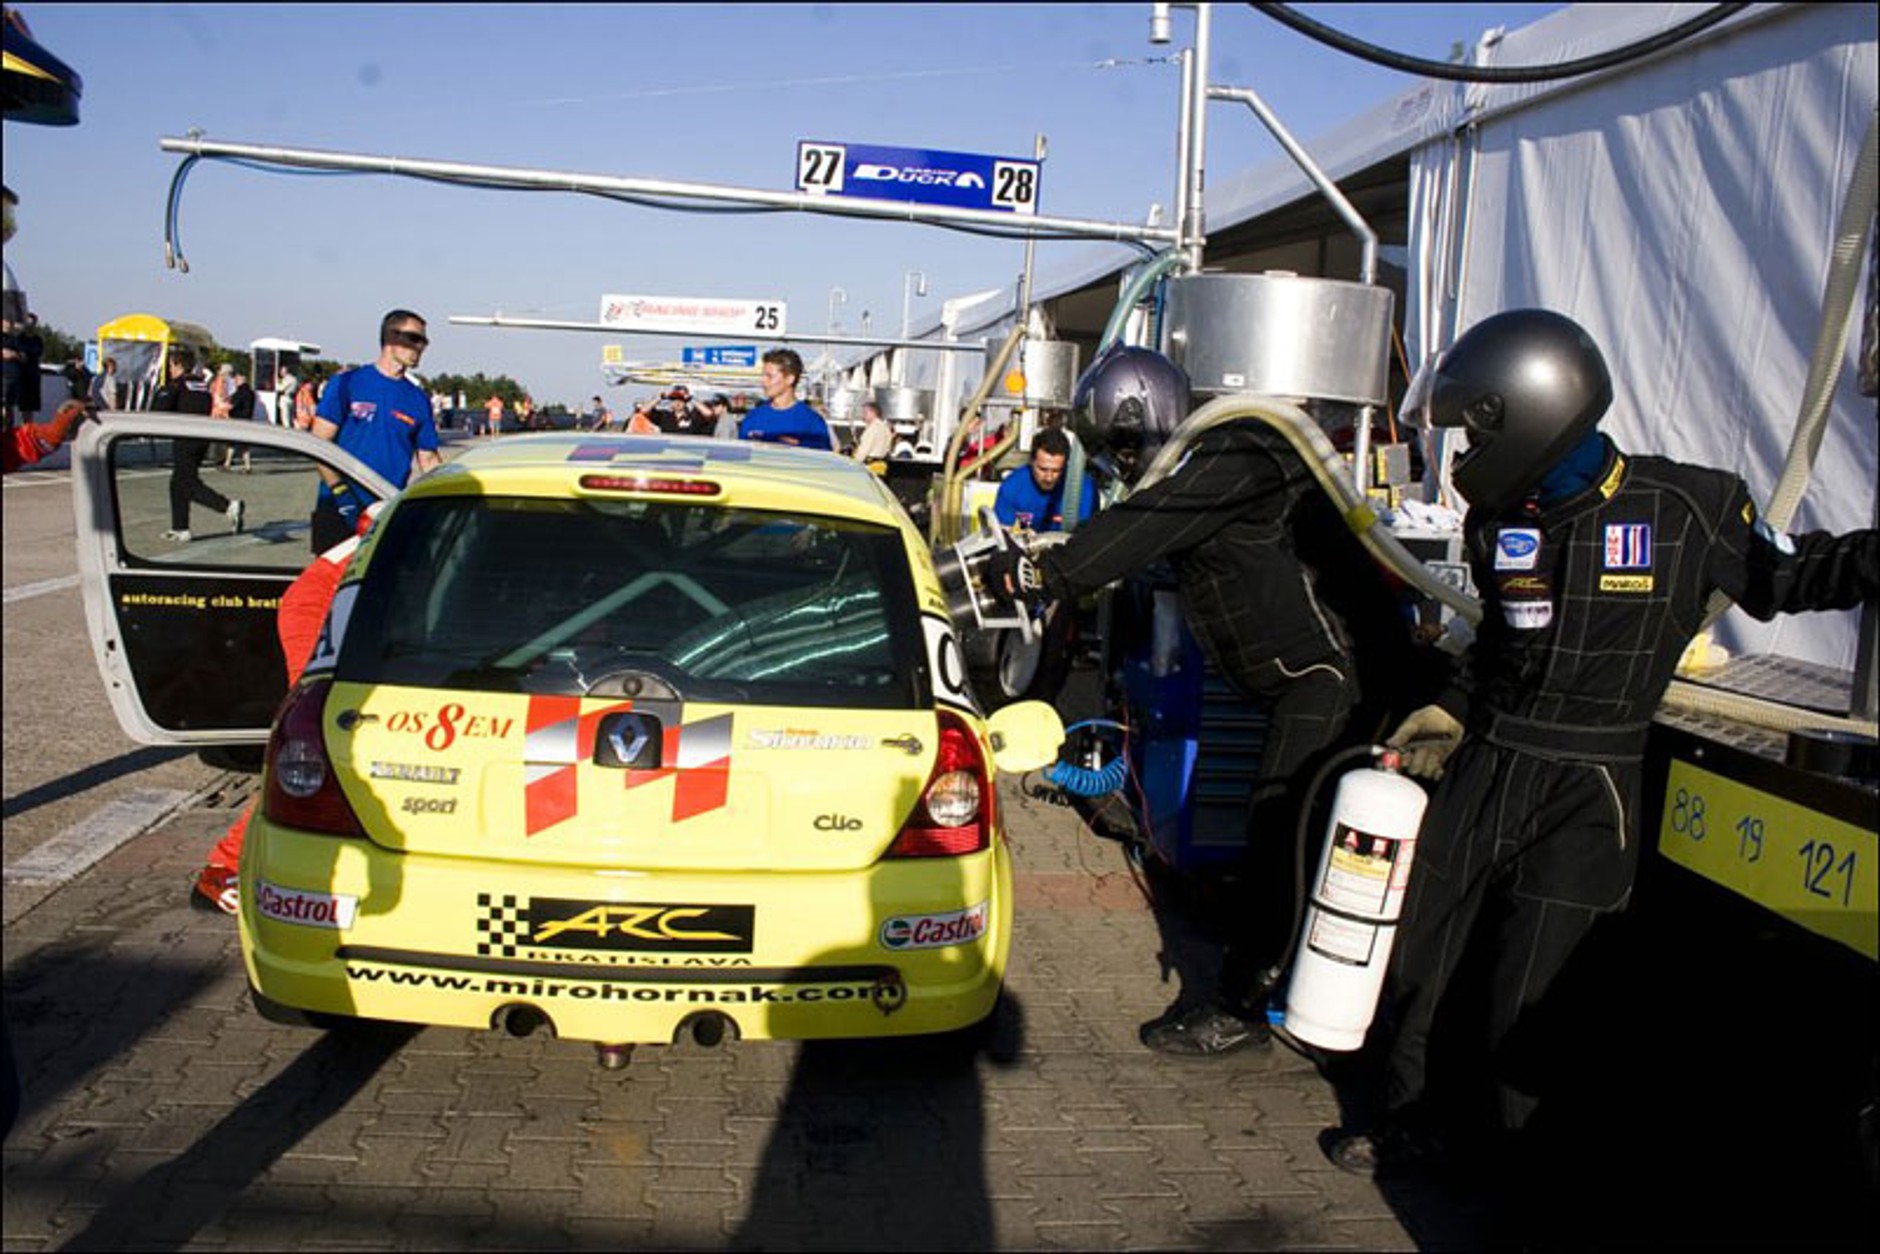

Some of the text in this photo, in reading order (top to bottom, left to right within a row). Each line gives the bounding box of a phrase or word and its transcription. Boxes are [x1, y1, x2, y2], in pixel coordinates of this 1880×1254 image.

[803, 148, 841, 186] 27
[996, 167, 1034, 204] 28
[754, 305, 779, 331] 25
[122, 593, 206, 610] autoracing
[211, 595, 243, 608] club
[402, 797, 458, 815] sport
[813, 813, 863, 831] Clio
[1671, 787, 1857, 908] 88 19 121
[262, 886, 338, 924] Castrol
[914, 907, 984, 944] Castrol
[346, 967, 898, 1003] www.mirohornak.com
